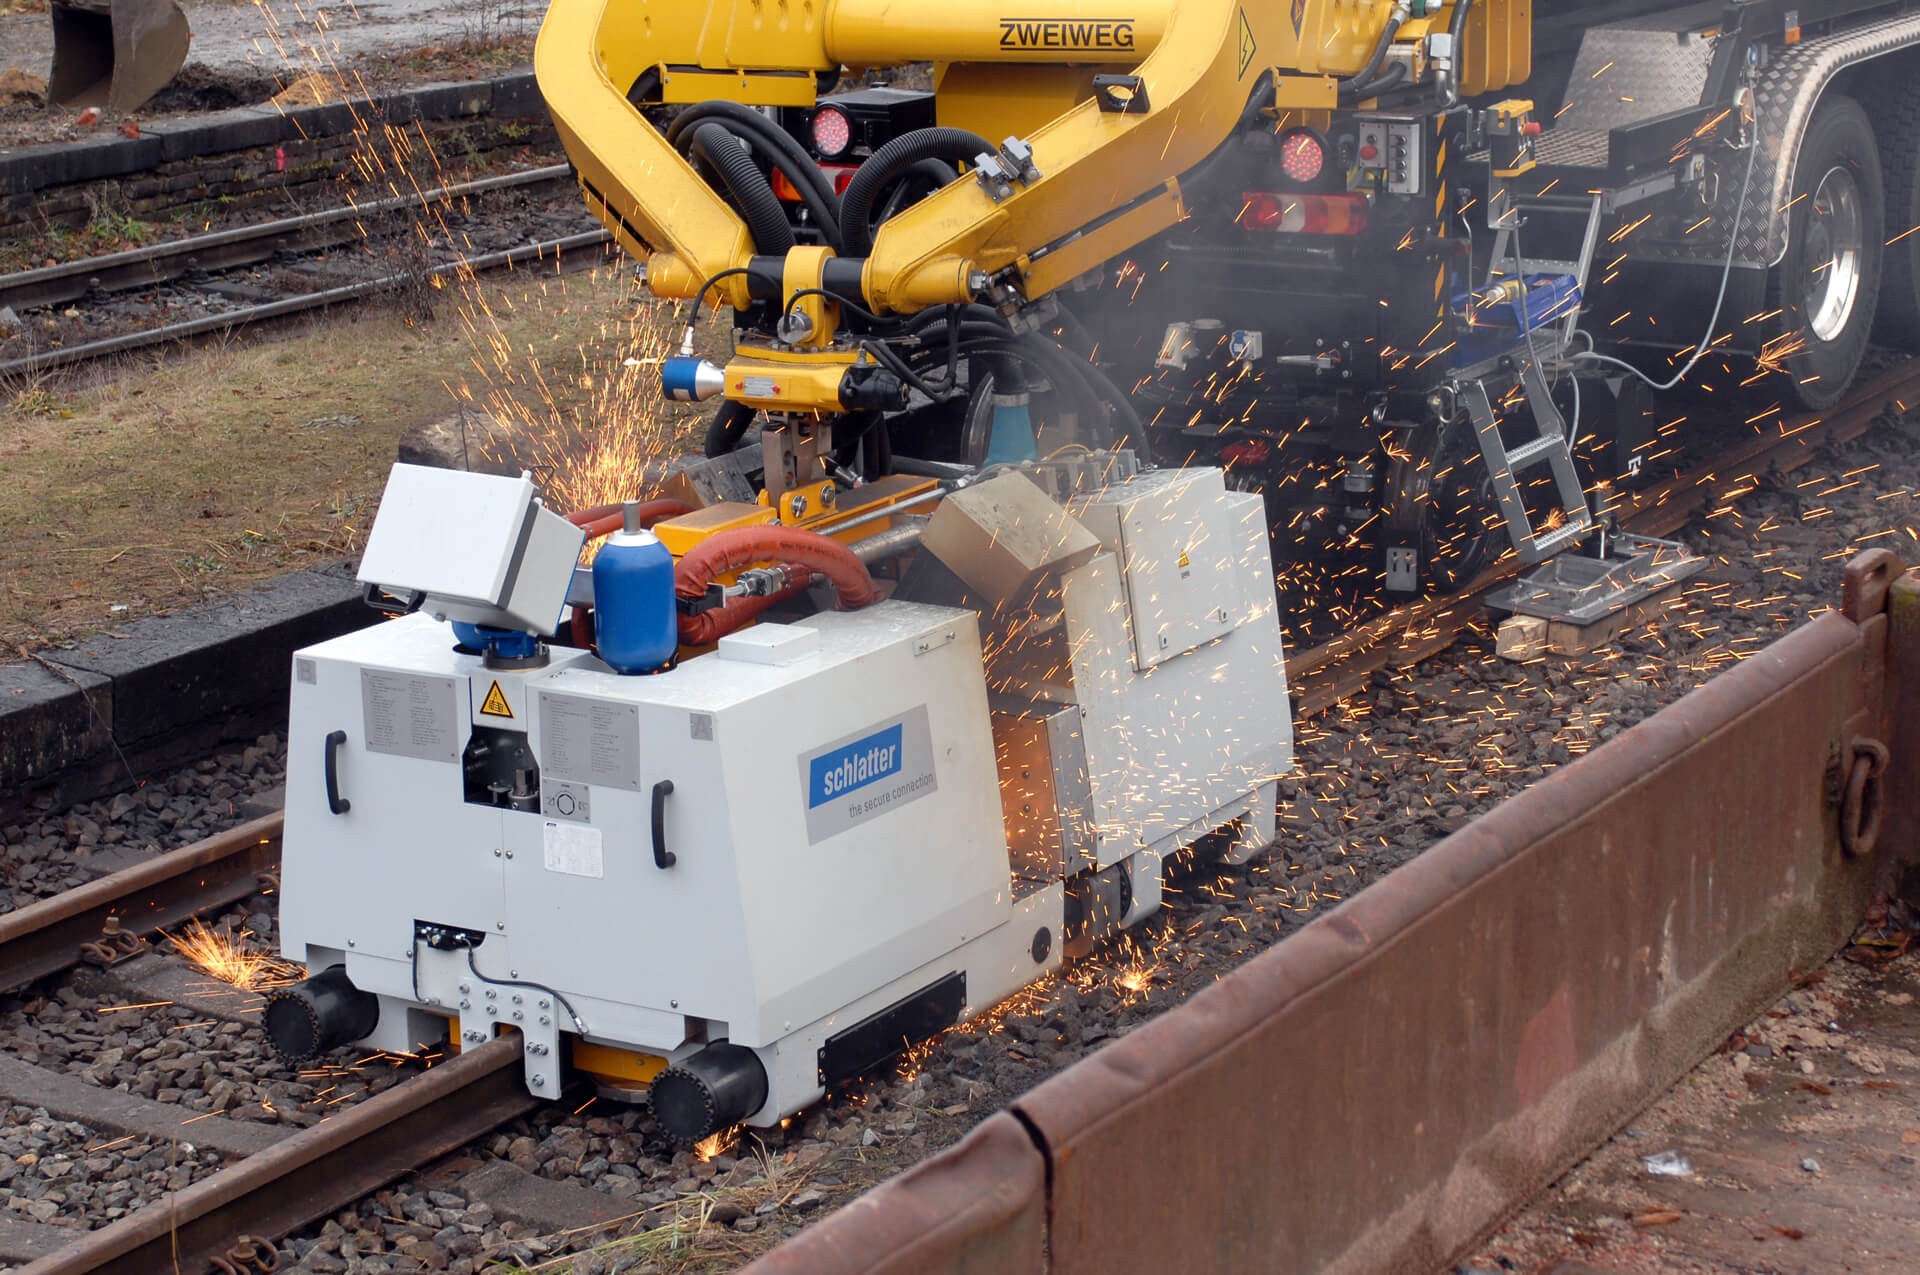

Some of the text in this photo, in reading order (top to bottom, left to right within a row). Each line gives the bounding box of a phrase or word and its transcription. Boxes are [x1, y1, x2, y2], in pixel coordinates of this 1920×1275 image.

[1000, 23, 1134, 47] ZWEIWEG
[823, 743, 896, 796] schlatter
[849, 772, 934, 818] the secure connection
